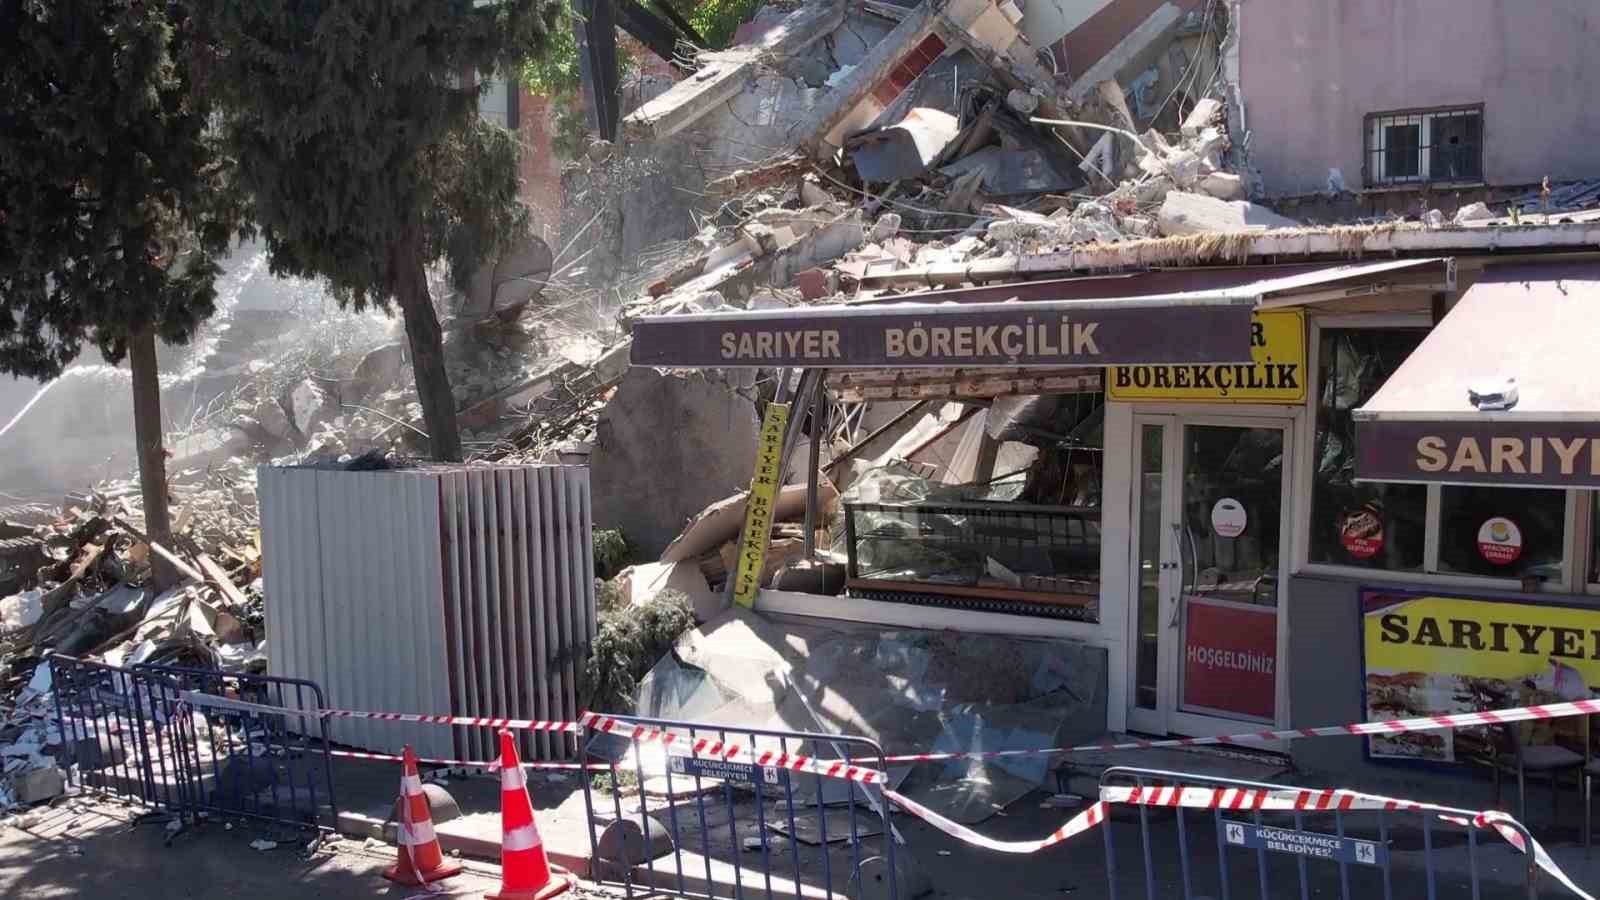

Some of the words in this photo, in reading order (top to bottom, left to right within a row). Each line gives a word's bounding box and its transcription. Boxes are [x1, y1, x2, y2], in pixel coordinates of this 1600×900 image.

[720, 330, 841, 359] SARIYER
[885, 315, 1100, 364] BÖREKÇİLİK
[1186, 645, 1275, 674] HOŞGELDİNİZ
